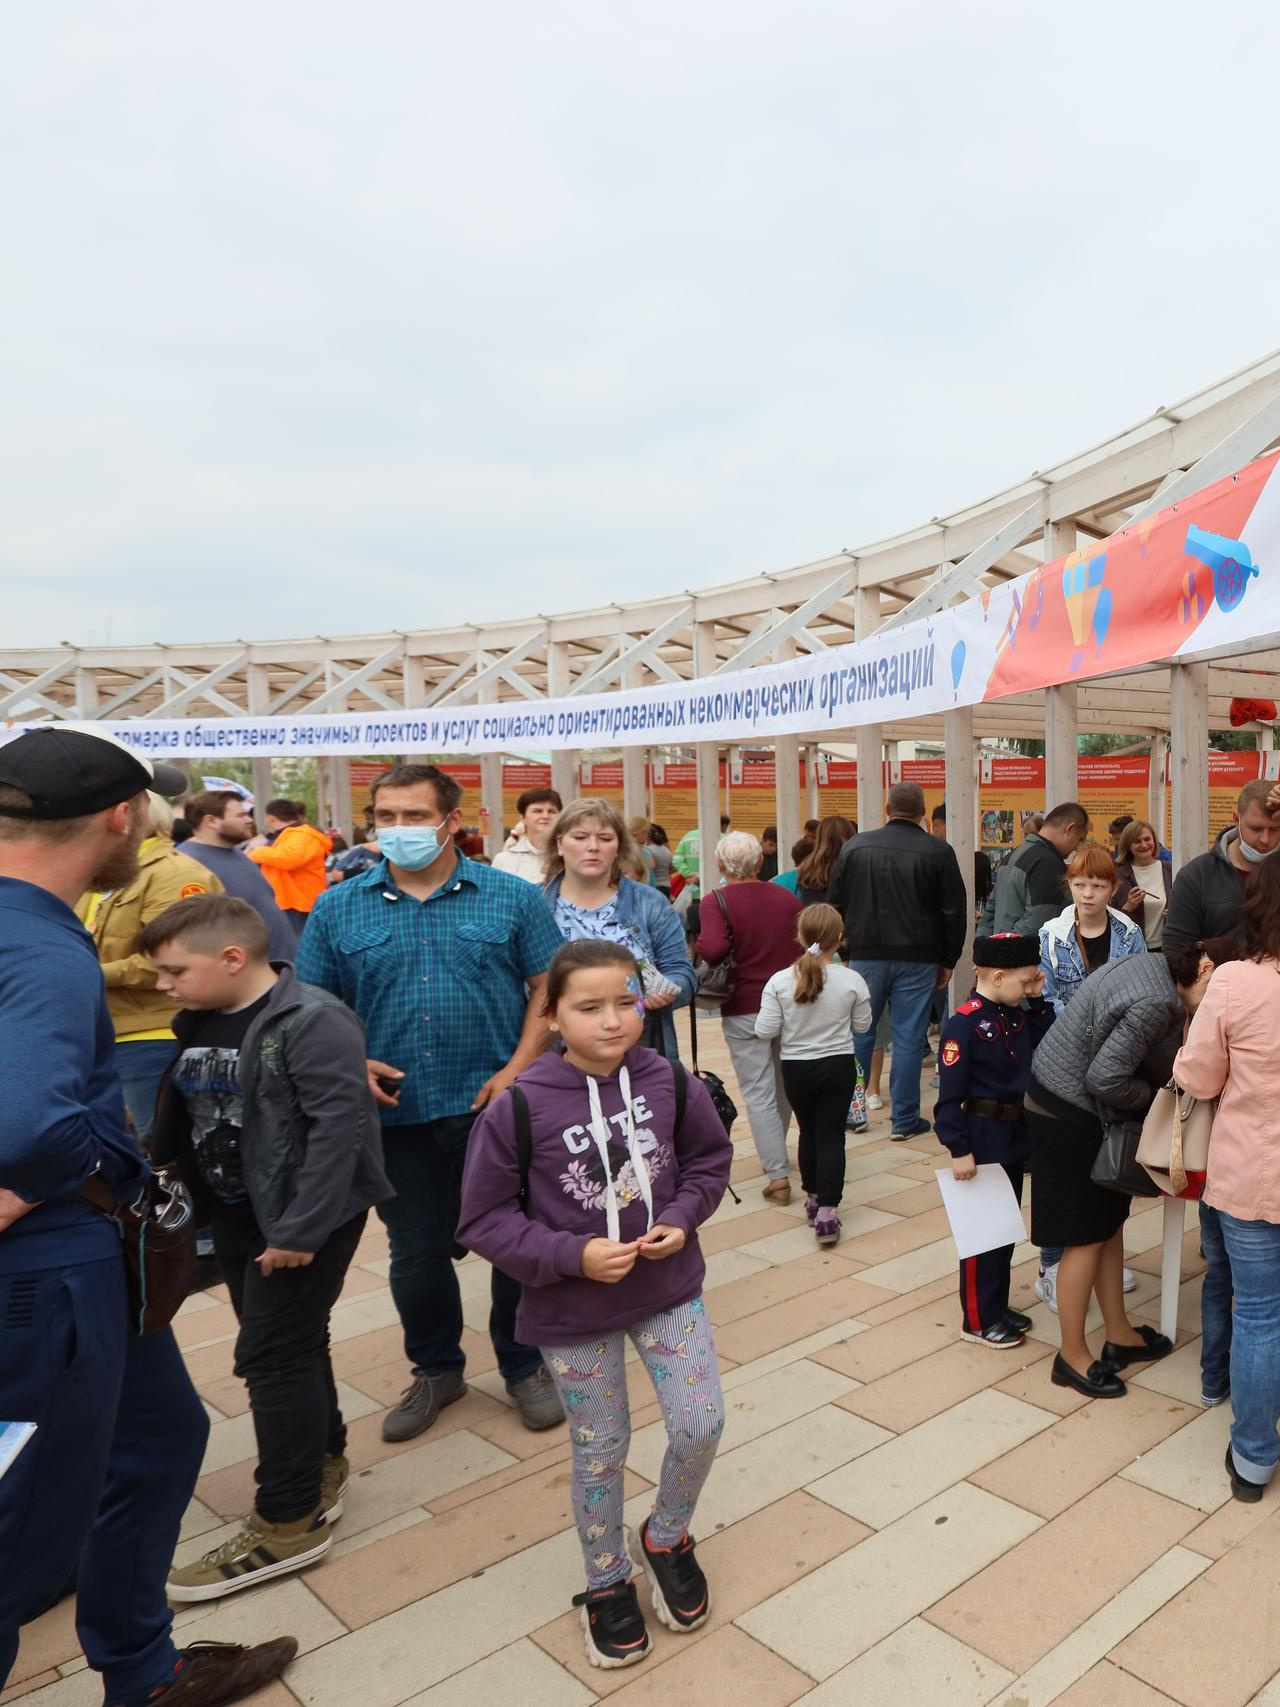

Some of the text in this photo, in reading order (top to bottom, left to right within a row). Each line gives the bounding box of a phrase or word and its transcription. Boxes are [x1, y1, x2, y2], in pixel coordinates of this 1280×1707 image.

[184, 725, 284, 750] общественно
[290, 725, 360, 746] значимых
[366, 720, 426, 749] проектов
[430, 722, 439, 740] и
[442, 718, 480, 746] услуг
[483, 711, 554, 742] социально
[558, 692, 686, 737] ориентированных
[689, 680, 815, 727] некоммерческих
[819, 629, 937, 718] организаций
[561, 1094, 653, 1155] CUTE
